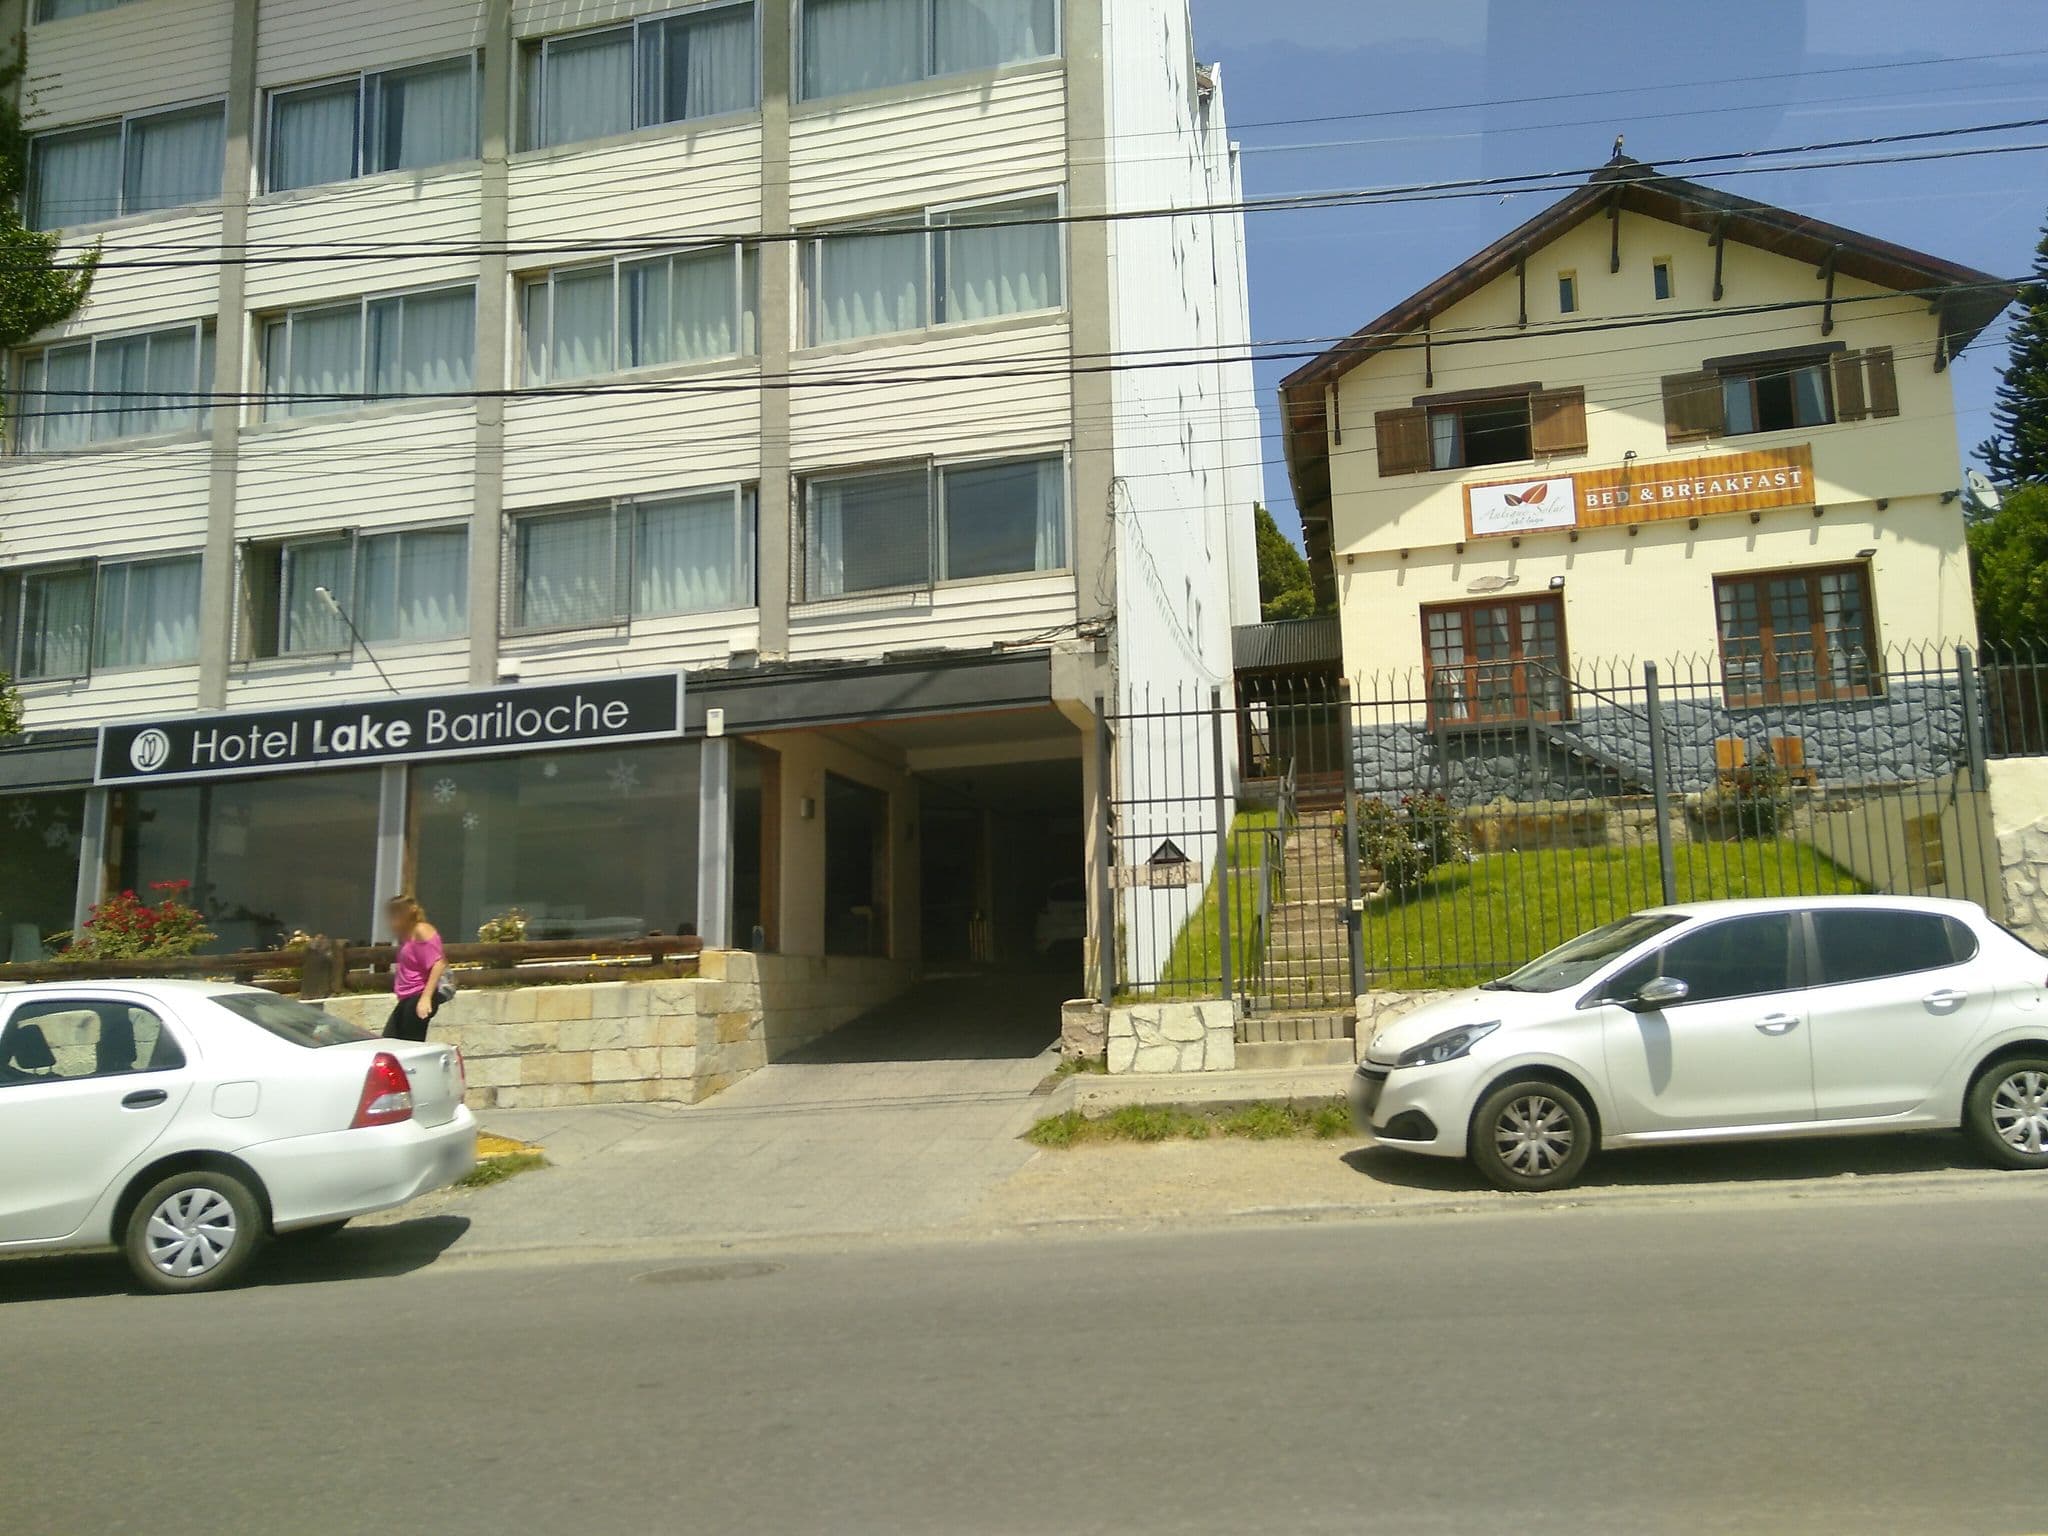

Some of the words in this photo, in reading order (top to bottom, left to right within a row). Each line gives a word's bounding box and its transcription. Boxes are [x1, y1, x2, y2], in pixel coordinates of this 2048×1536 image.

[1585, 490, 1630, 508] BED
[1639, 487, 1654, 501] &
[1661, 471, 1802, 499] BREAKFAST
[191, 720, 298, 765] Hotel
[312, 713, 413, 755] Lake
[426, 695, 629, 745] Bariloche
